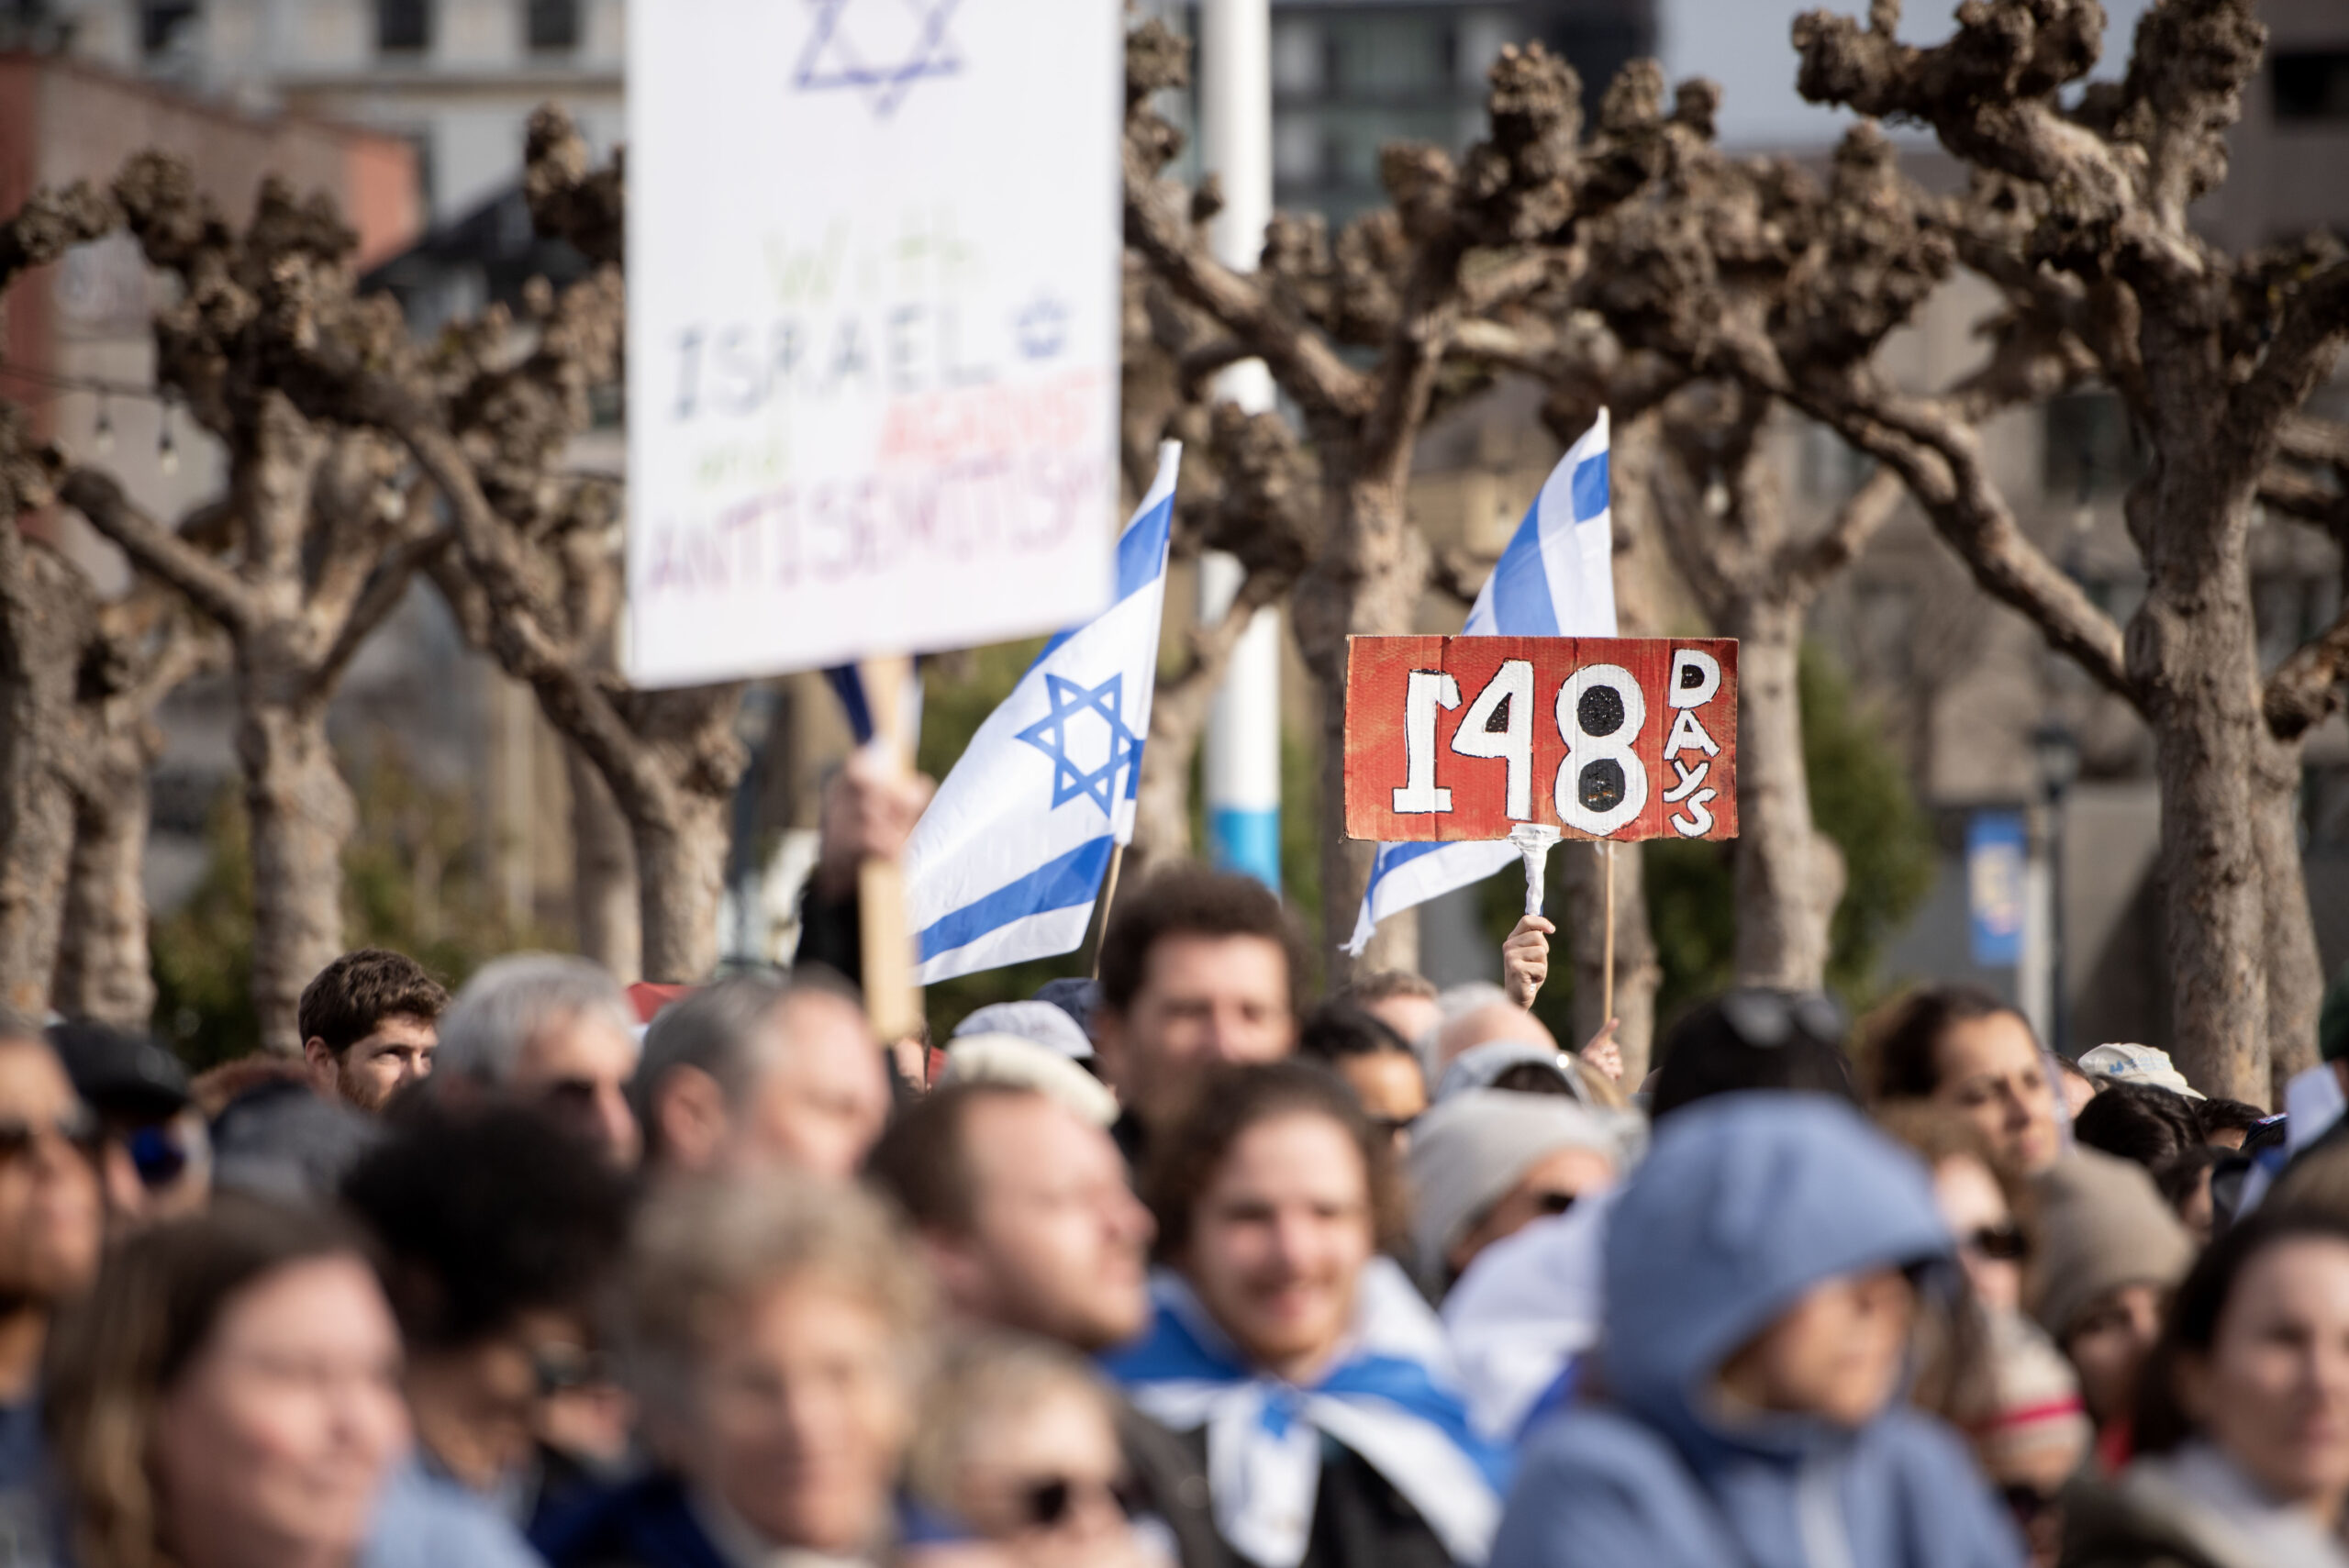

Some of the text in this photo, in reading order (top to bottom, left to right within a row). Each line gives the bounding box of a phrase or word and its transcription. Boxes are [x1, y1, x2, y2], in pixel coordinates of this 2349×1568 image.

[669, 302, 999, 423] ISRAEL
[1393, 658, 1648, 836] 148
[1663, 649, 1722, 838] DAYS
